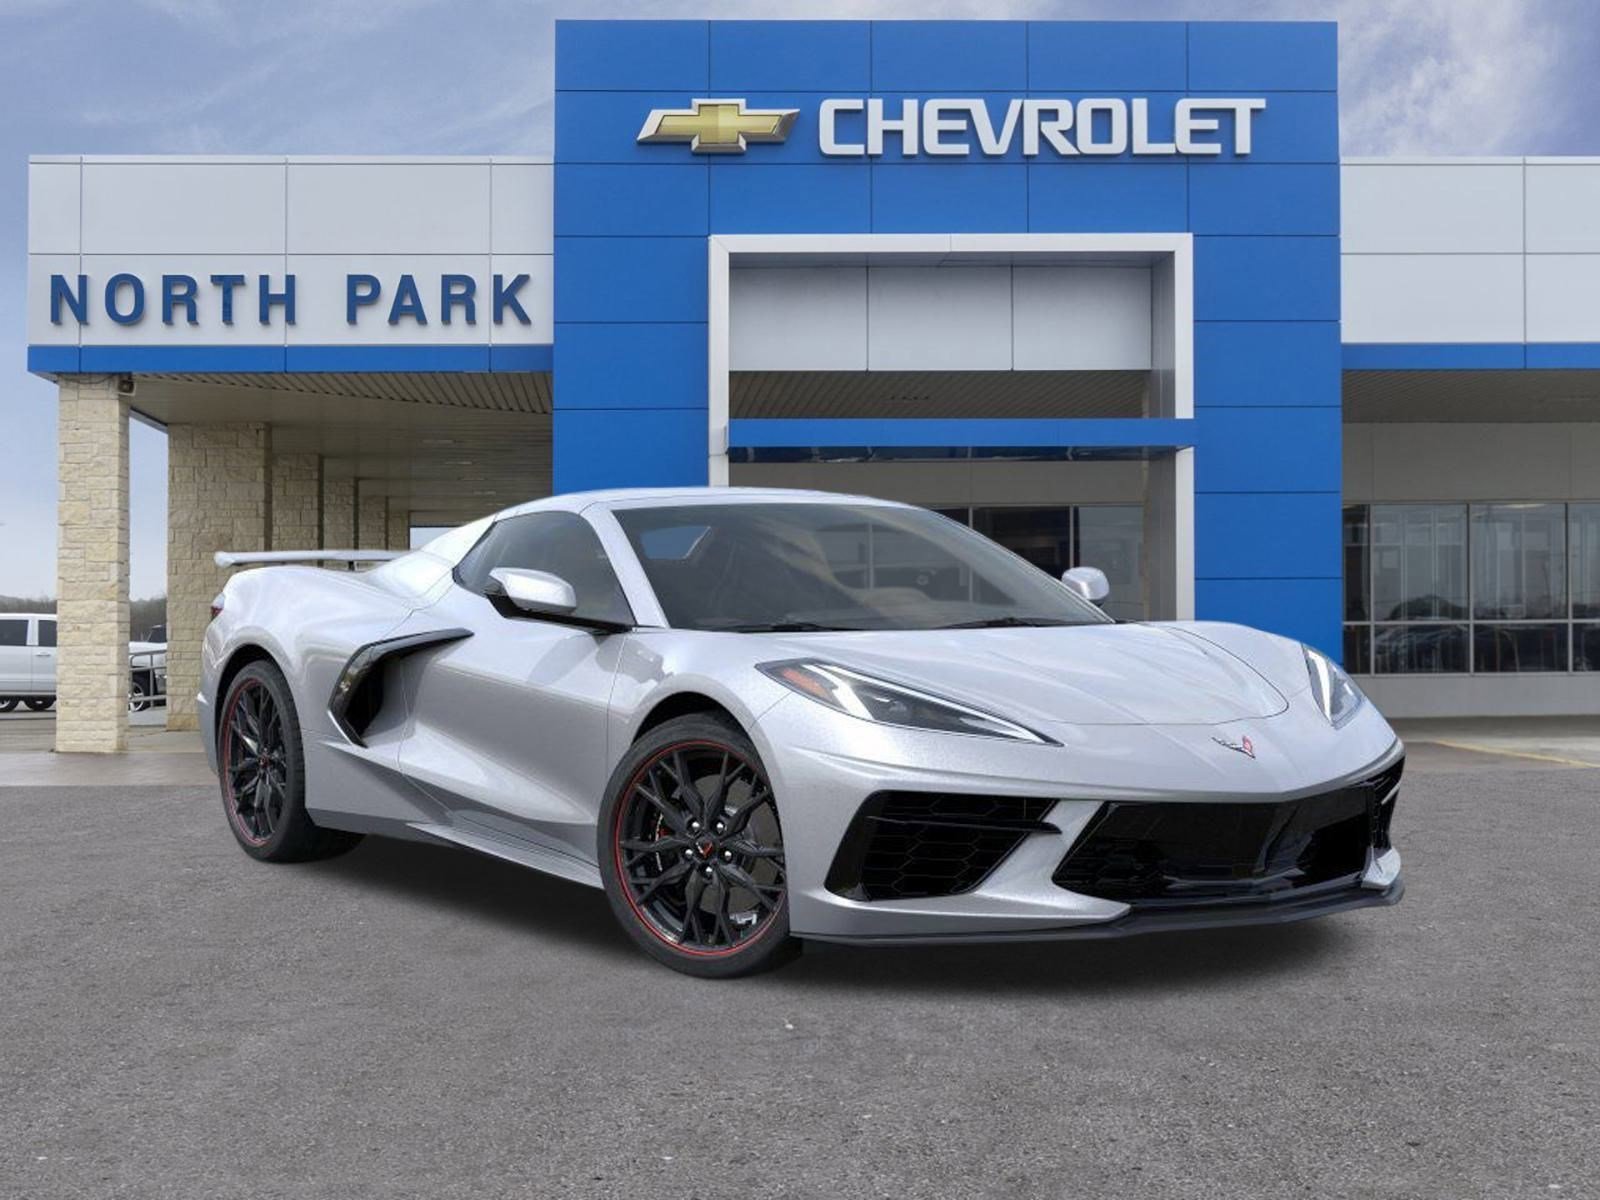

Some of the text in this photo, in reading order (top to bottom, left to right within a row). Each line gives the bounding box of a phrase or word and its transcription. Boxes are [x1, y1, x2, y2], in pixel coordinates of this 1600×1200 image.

[819, 98, 1266, 156] CHEVROLET
[50, 273, 532, 326] NORTH PARK
